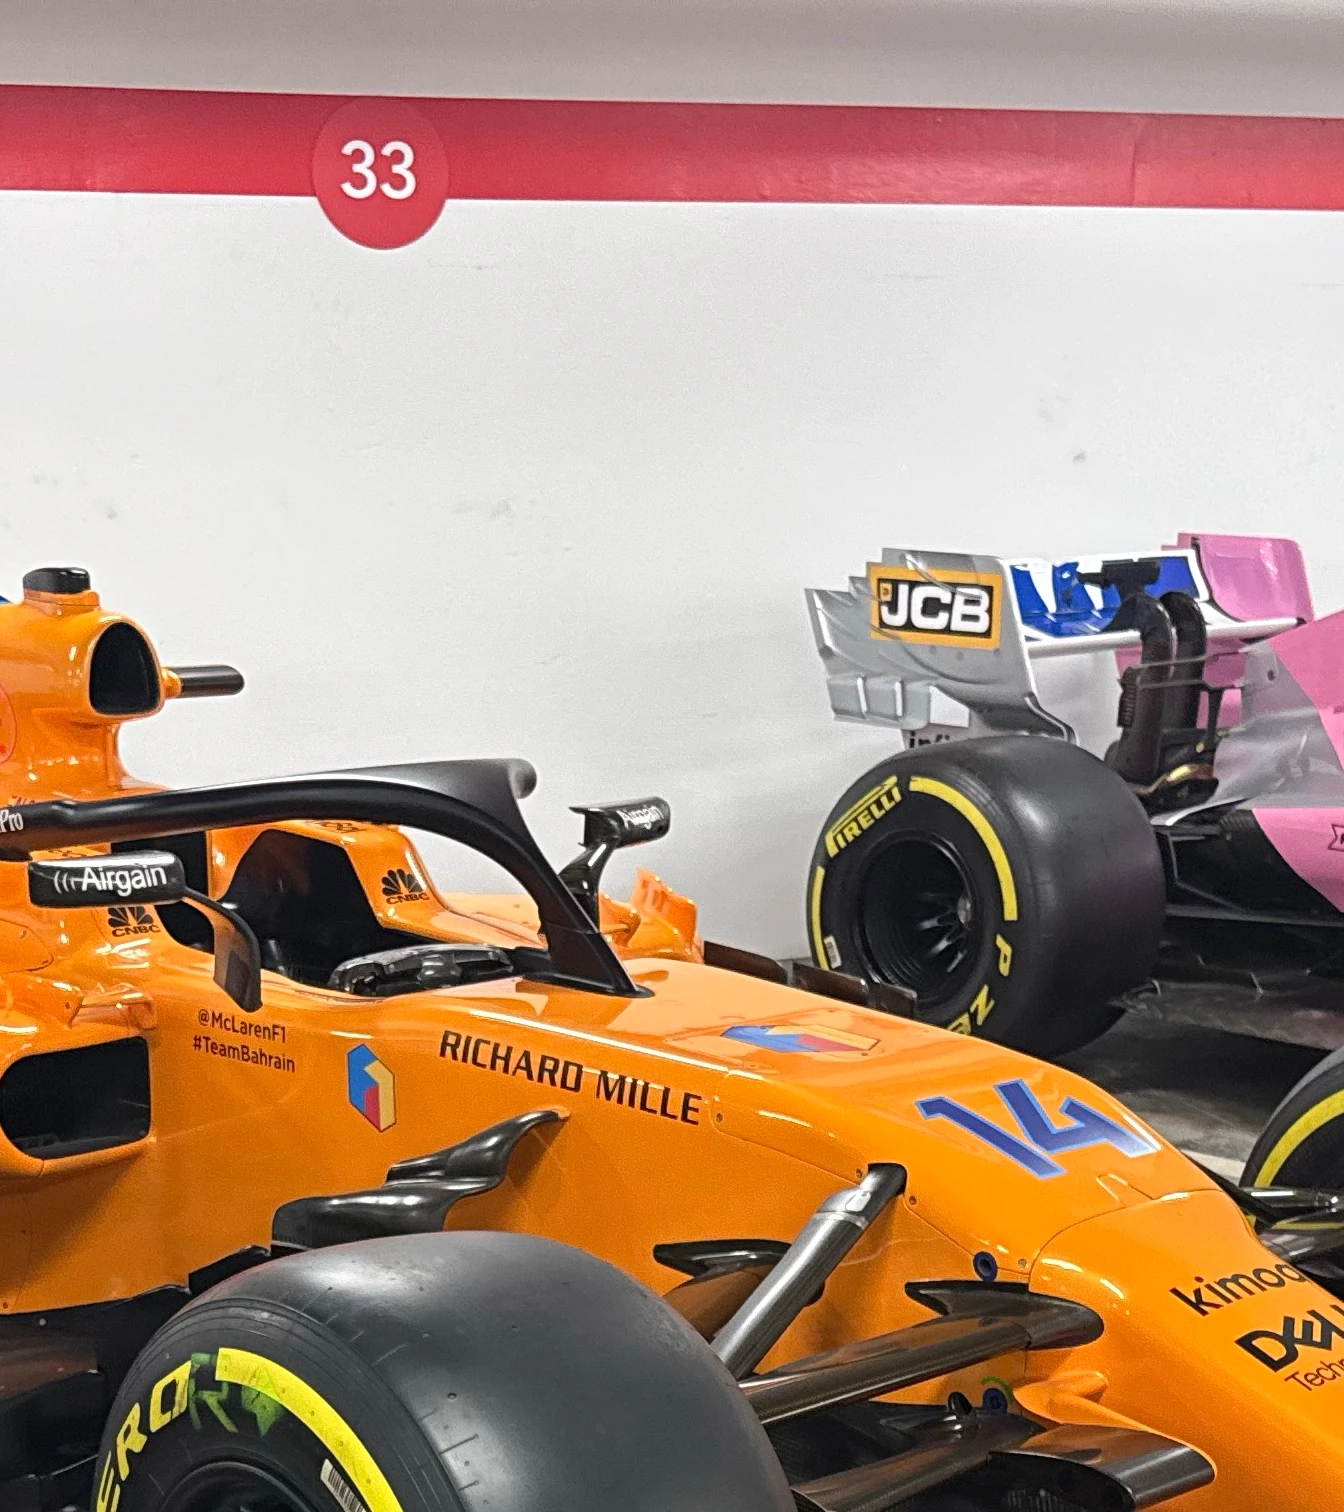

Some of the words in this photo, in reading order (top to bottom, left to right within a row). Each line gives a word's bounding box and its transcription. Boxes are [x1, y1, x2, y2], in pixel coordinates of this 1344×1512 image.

[340, 139, 416, 200] 33
[882, 583, 991, 634] JCB
[824, 774, 903, 858] PIRELLI
[81, 863, 167, 897] Airgain
[111, 924, 161, 938] CNBC
[197, 1008, 287, 1044] @McLarenF1
[193, 1034, 297, 1074] #TeamBahrain
[439, 1030, 584, 1094] RICHARD
[595, 1070, 702, 1127] MILLE
[914, 1078, 1159, 1180] 14
[1169, 1262, 1309, 1318] kimoa
